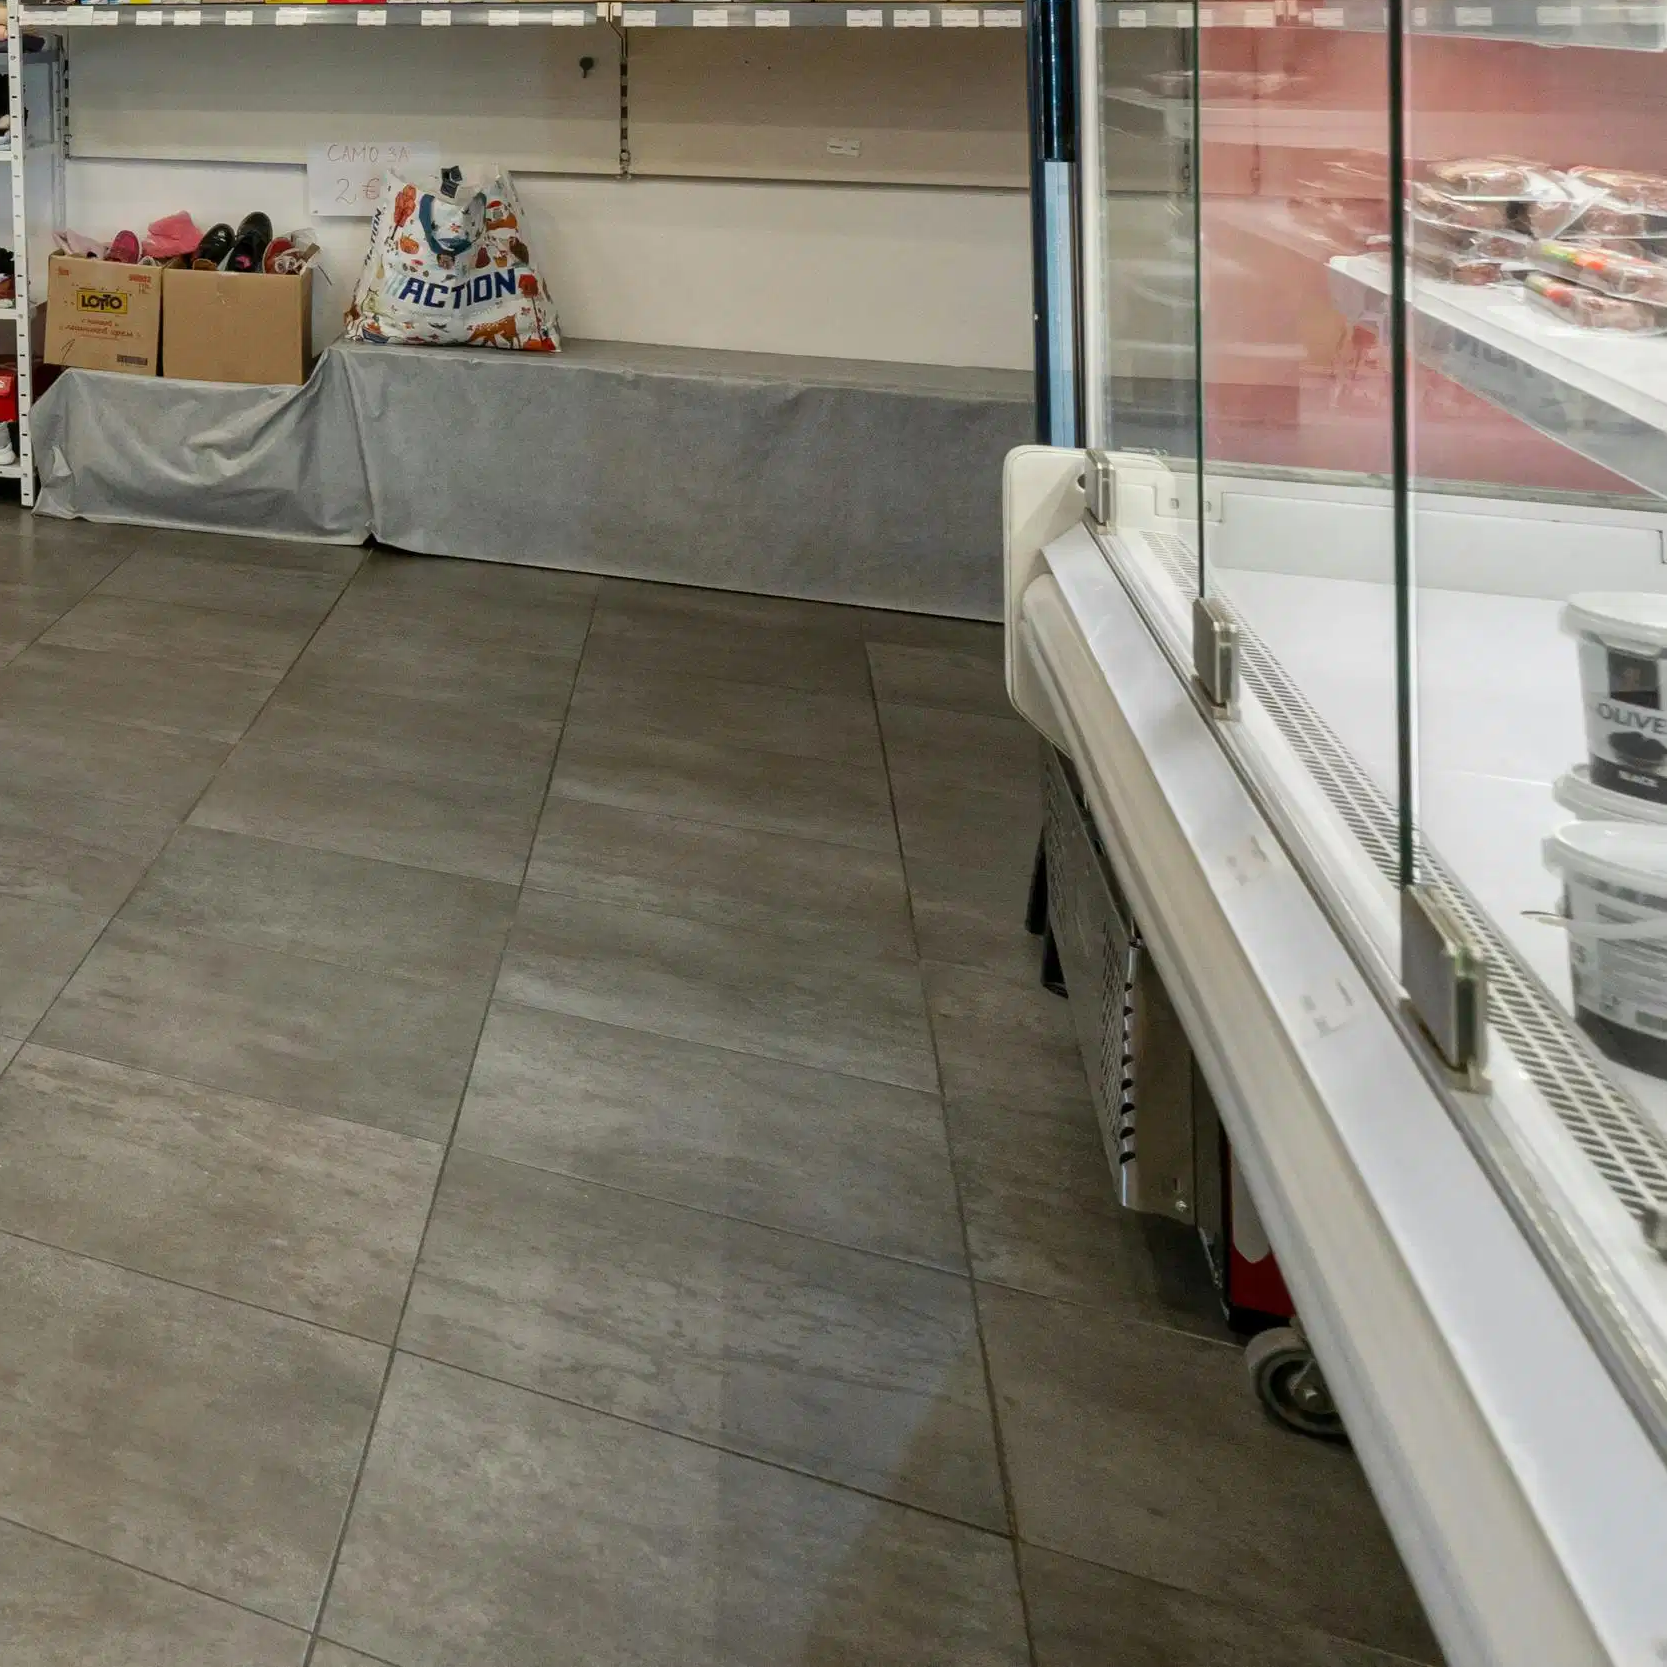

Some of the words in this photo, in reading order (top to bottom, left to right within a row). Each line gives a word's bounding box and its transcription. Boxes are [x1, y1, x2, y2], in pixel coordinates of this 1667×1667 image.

[336, 178, 355, 204] 2
[81, 293, 122, 311] LOTTO
[399, 270, 517, 310] ACTION
